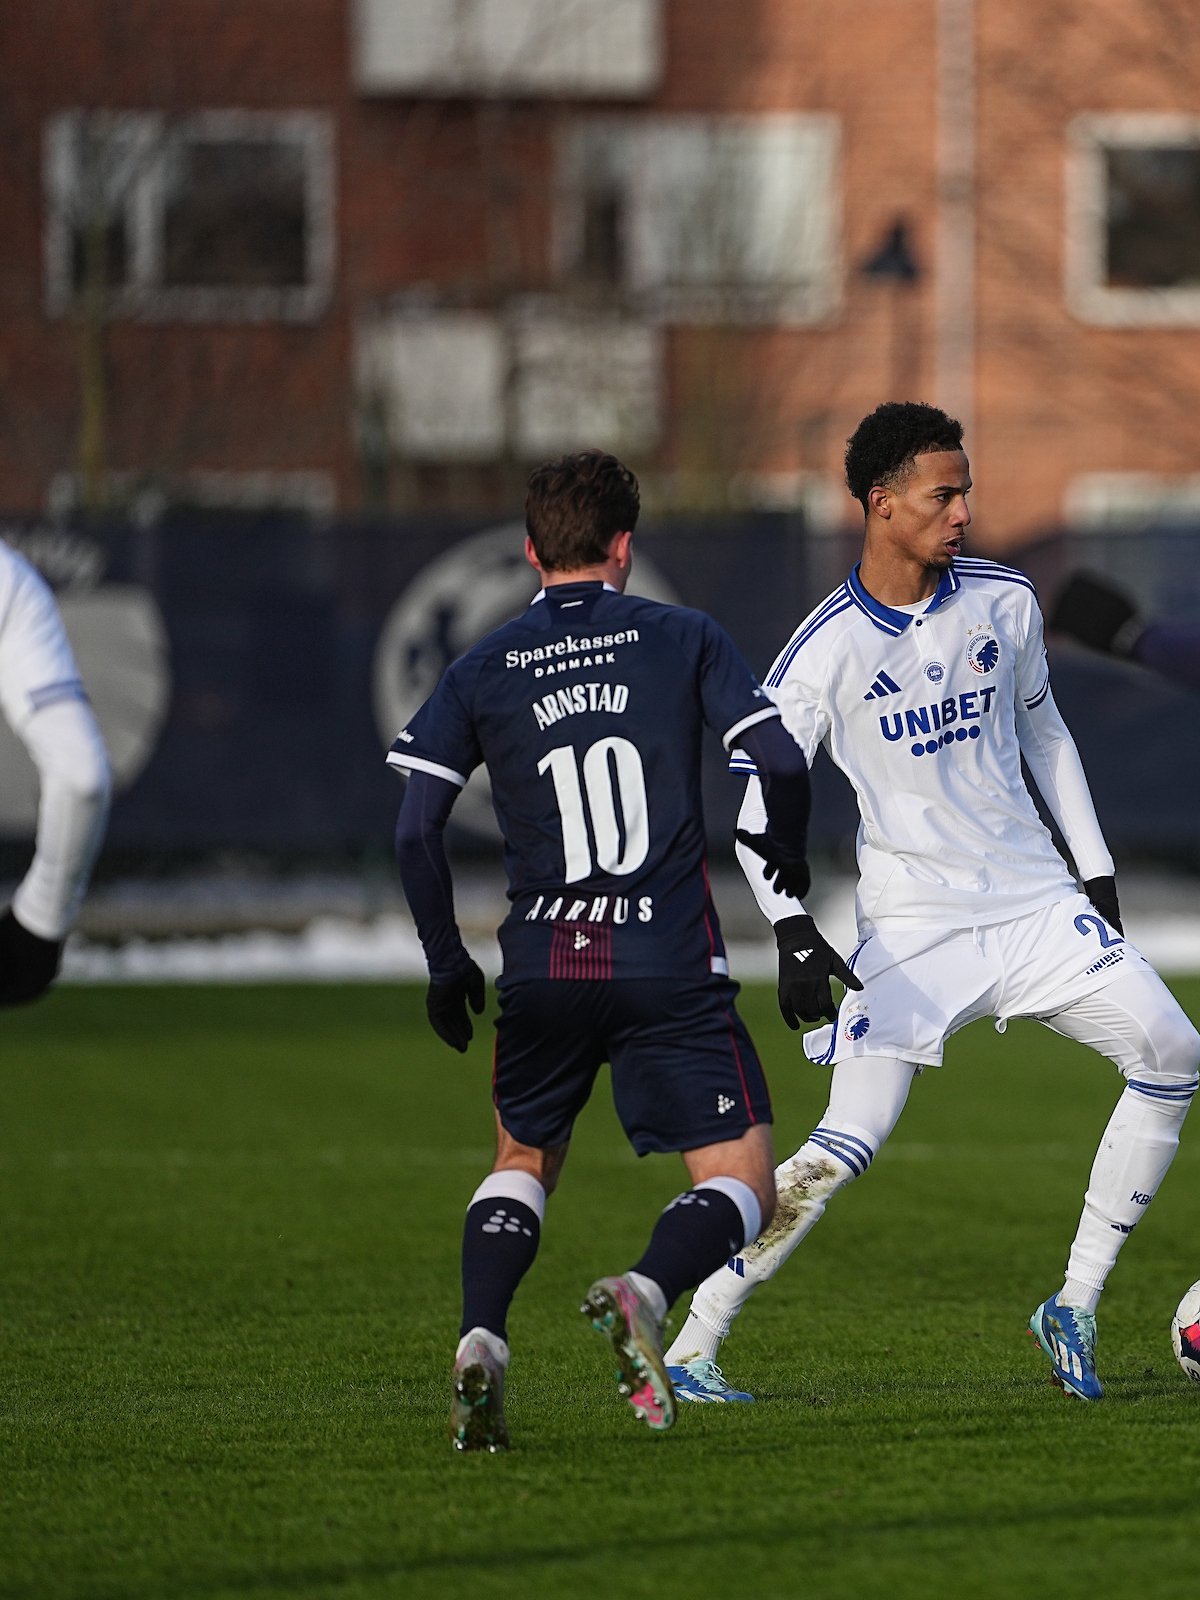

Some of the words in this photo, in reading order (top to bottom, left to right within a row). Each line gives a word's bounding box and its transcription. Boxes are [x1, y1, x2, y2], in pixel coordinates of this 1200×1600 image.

[505, 629, 639, 669] Sparekassen
[534, 652, 615, 678] DANMARK
[532, 683, 629, 731] ARNSTAD
[880, 686, 996, 741] UNIBET
[537, 736, 649, 885] 10
[525, 896, 653, 925] AARHUS
